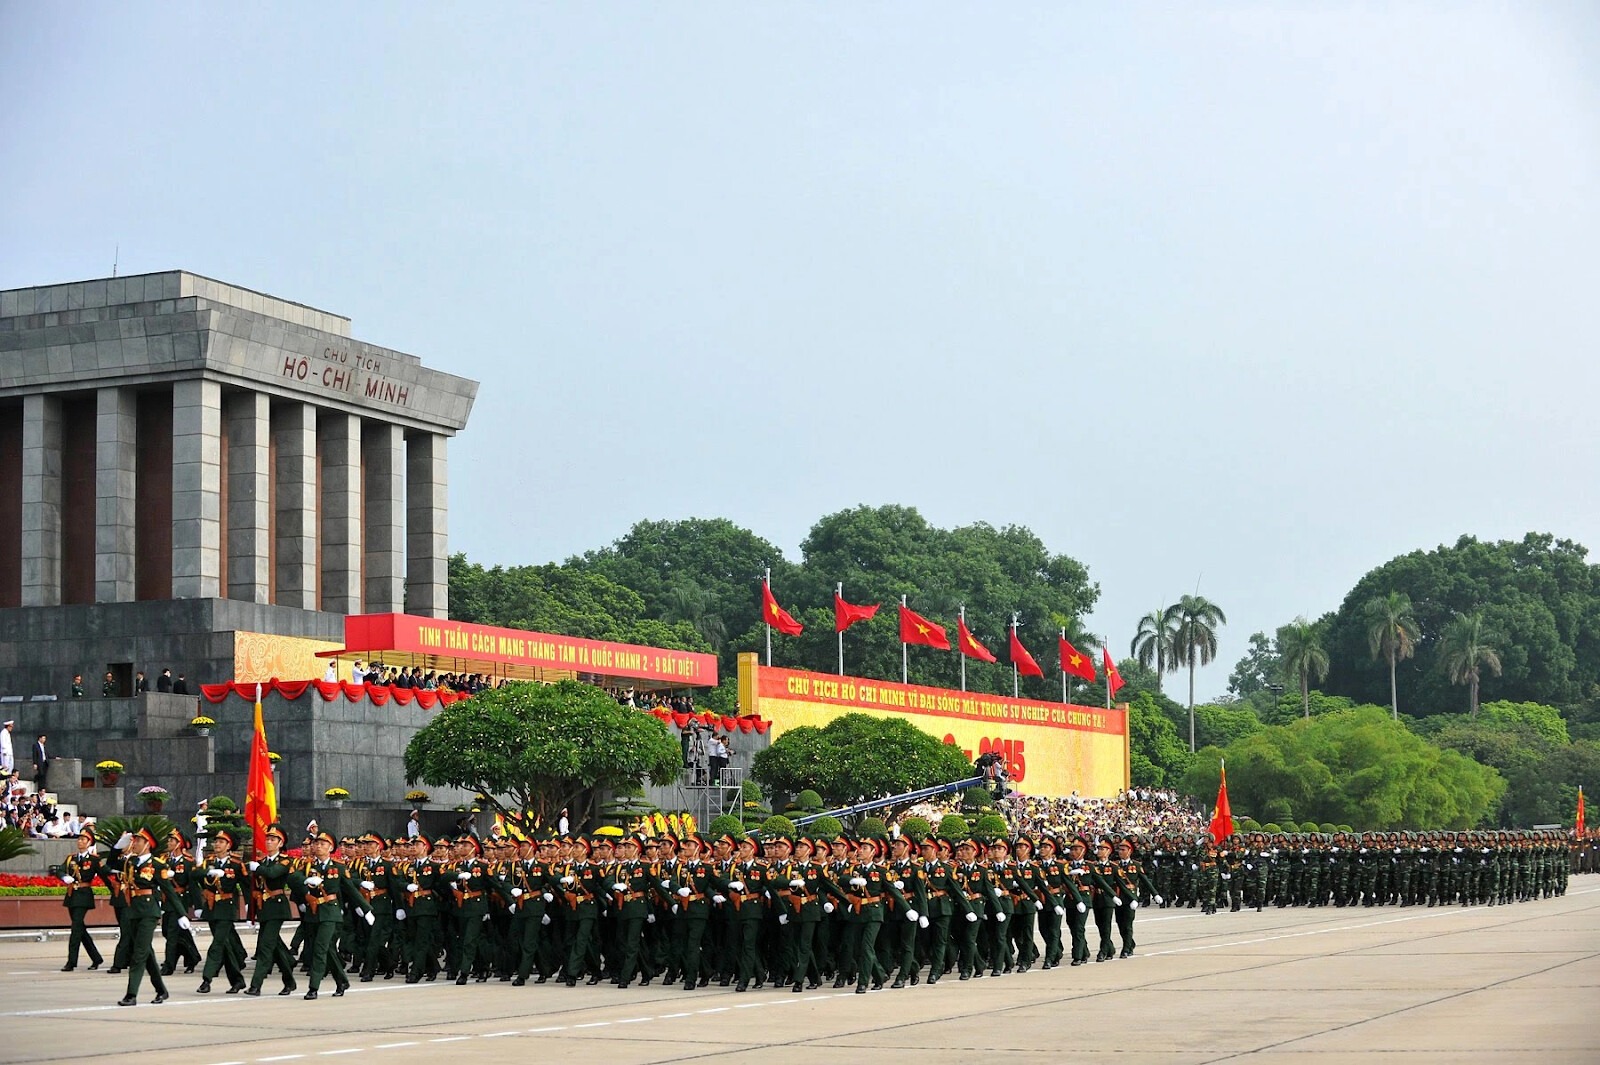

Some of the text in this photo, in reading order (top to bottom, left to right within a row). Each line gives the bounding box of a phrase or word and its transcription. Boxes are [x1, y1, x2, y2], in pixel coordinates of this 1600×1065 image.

[364, 375, 409, 406] MINH
[419, 626, 441, 647] TINH
[472, 631, 496, 654] CÁCH
[499, 637, 525, 660] MẠNG
[527, 639, 556, 662] THÁNG
[558, 641, 576, 663] TÁM
[578, 644, 589, 665] VÀ
[591, 645, 613, 668] QUỐC
[615, 650, 641, 671] KHÁNH
[662, 652, 676, 675] BẤT
[678, 656, 694, 680] DIỆT
[787, 673, 810, 696] CHỦ
[812, 679, 839, 702] TỊCH
[841, 677, 856, 701] HỒ
[859, 684, 877, 703] CHÍ
[879, 688, 906, 707] MINH
[919, 693, 936, 713] ĐẠI
[937, 691, 961, 713] SỐNG
[980, 700, 1009, 719] TRONG
[1021, 704, 1050, 724] NGHIỆP
[1067, 708, 1091, 727] CHÚNG
